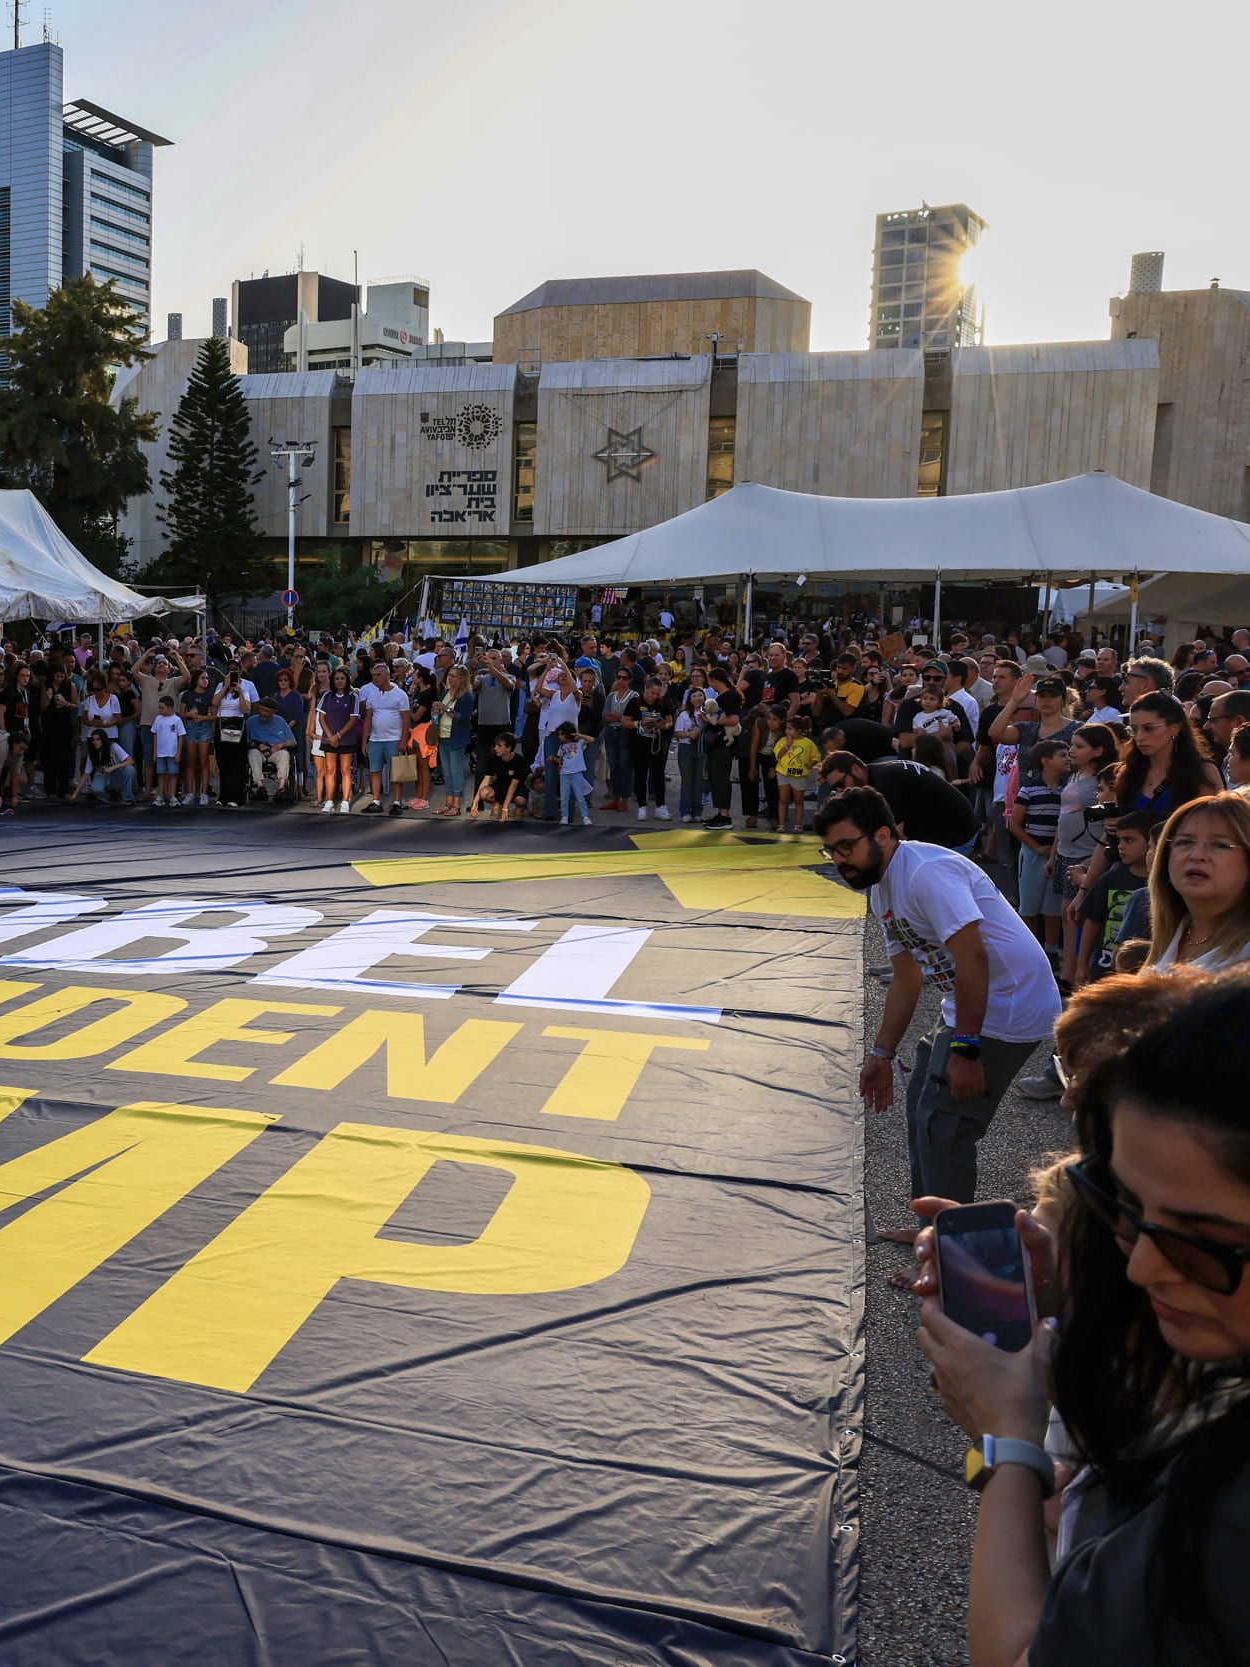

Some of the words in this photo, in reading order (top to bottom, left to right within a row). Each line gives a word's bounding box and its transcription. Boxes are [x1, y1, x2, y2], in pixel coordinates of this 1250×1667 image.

[433, 418, 445, 426] TEL
[438, 470, 497, 482] ספריית
[466, 497, 496, 508] בית
[431, 510, 496, 522] אריאלה
[787, 767, 805, 776] NOW
